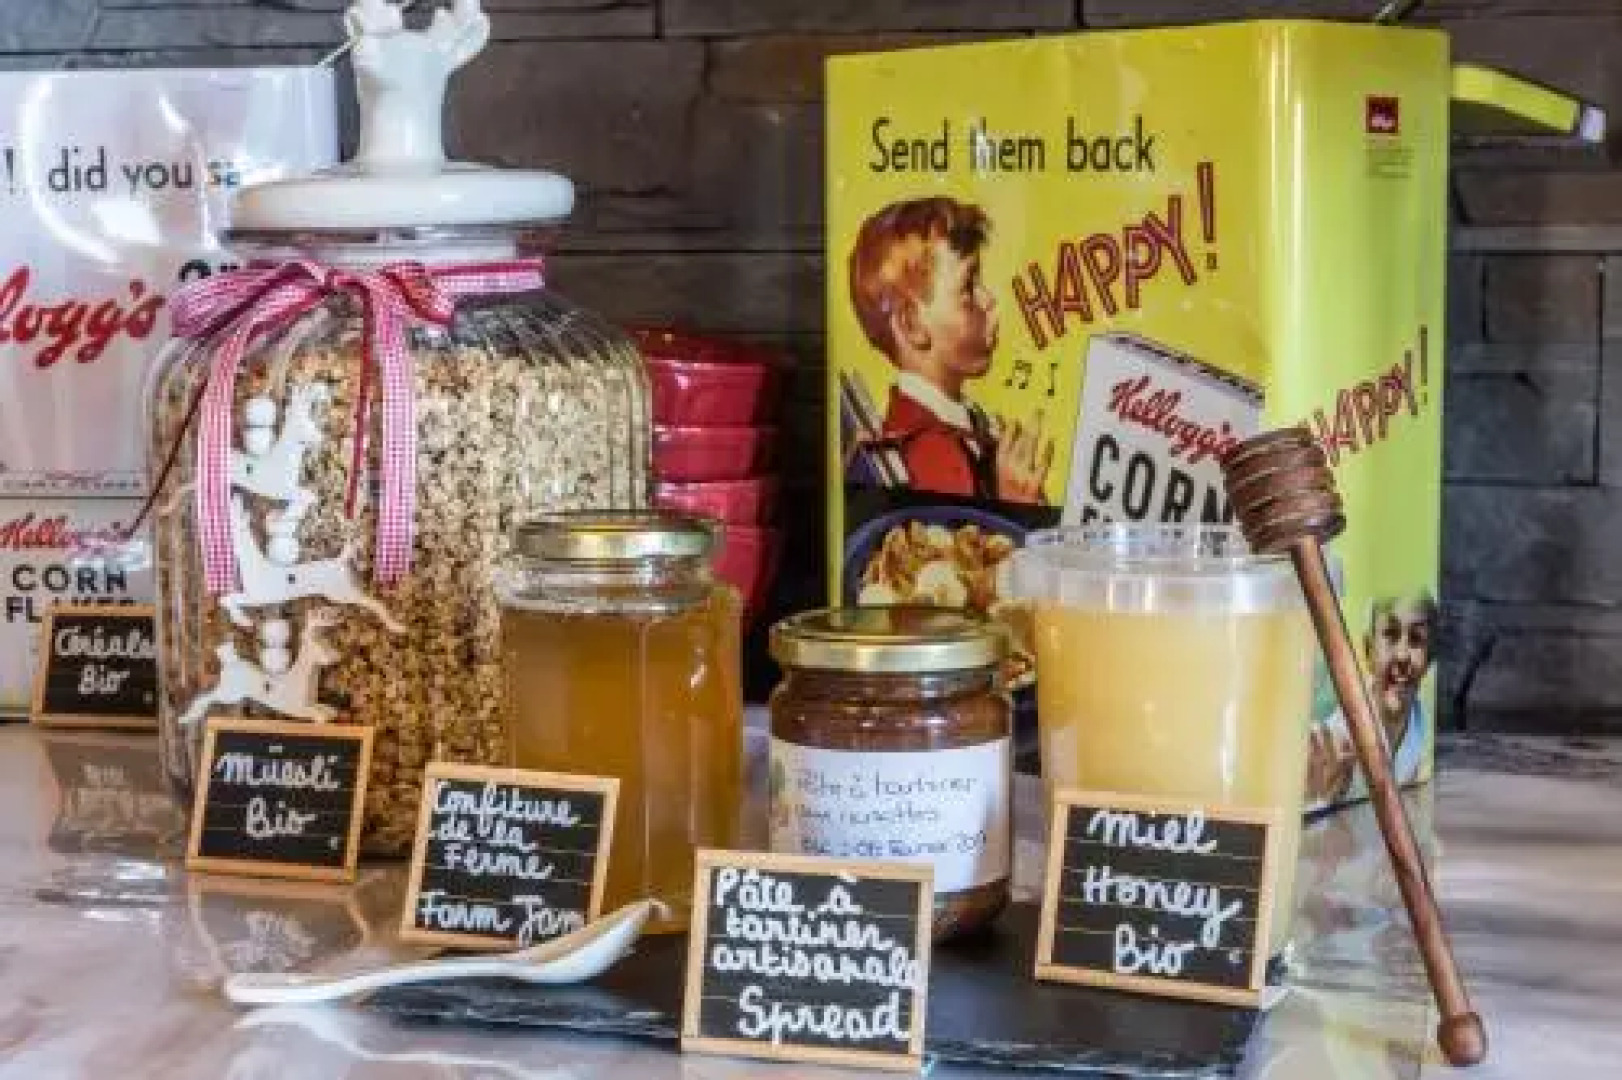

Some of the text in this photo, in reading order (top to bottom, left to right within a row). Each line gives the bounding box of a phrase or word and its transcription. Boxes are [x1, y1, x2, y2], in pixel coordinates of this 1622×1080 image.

[868, 112, 1157, 174] Send them back
[48, 145, 108, 192] did
[121, 160, 193, 193] you
[1011, 161, 1217, 351] HAPPY!
[12, 563, 128, 592] CORN
[245, 796, 317, 840] Bio
[1086, 808, 1218, 854] Miel
[443, 843, 556, 881] Ferme
[716, 866, 864, 916] Pâte à
[1081, 865, 1244, 949] Honey
[1113, 922, 1200, 976] Bio
[736, 984, 912, 1046] Spread
